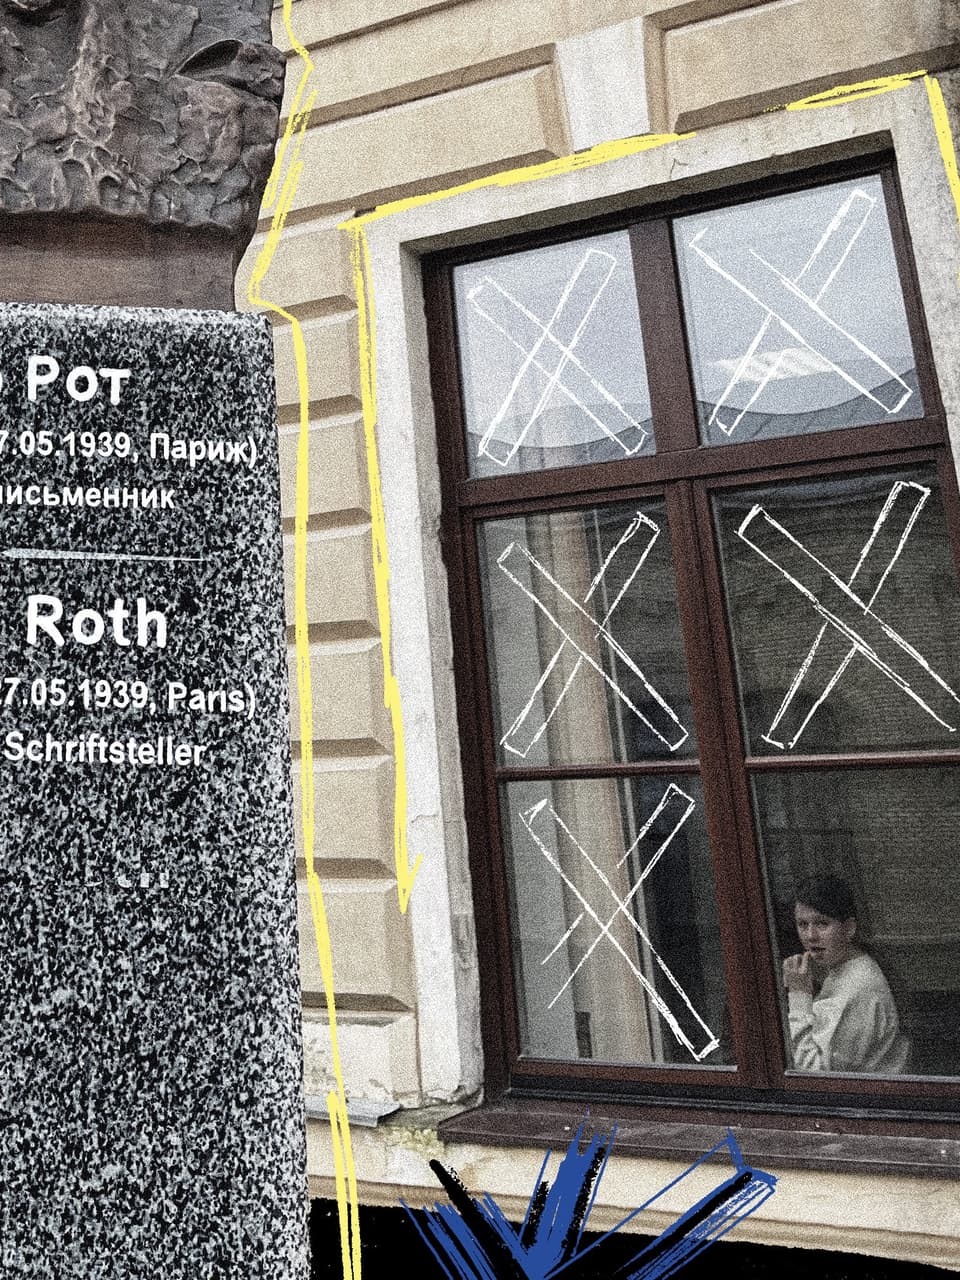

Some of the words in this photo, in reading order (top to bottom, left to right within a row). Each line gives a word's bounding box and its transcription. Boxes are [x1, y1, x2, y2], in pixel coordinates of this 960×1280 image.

[26, 355, 130, 406] Рот
[149, 432, 257, 469] Париж)
[25, 594, 168, 649] Roth
[167, 681, 256, 720] Paris)
[4, 731, 206, 767] Schriftsteller
